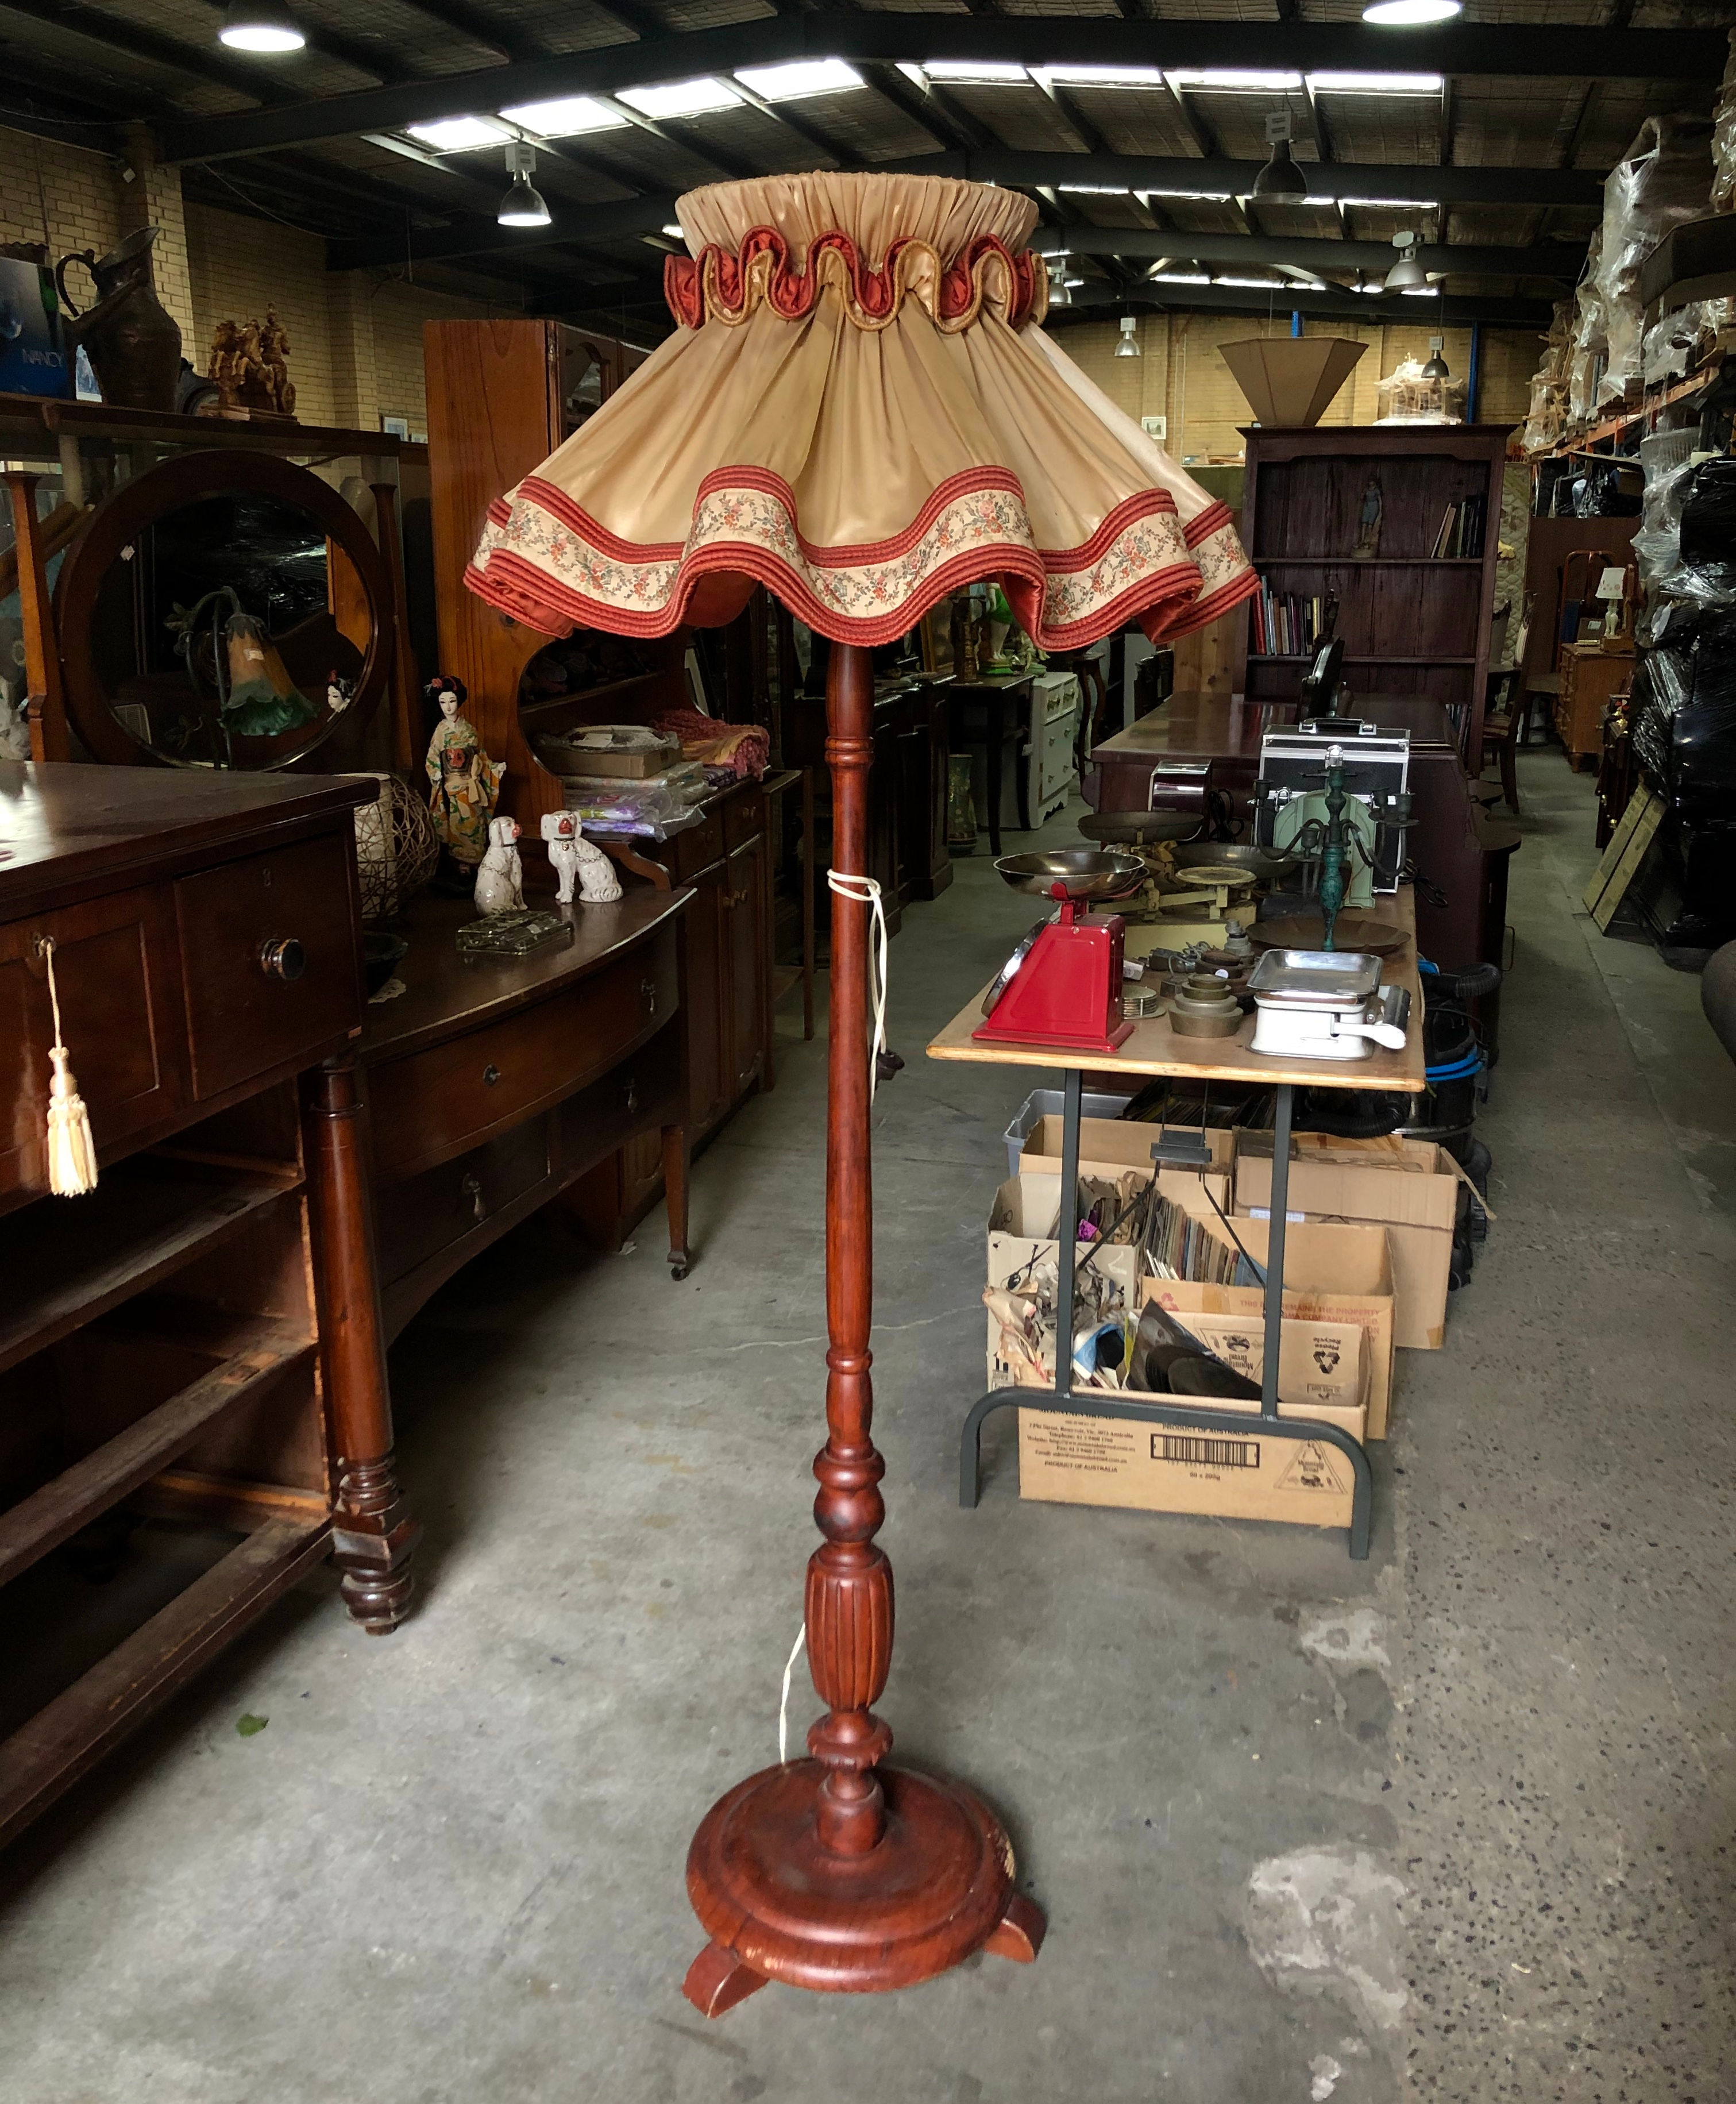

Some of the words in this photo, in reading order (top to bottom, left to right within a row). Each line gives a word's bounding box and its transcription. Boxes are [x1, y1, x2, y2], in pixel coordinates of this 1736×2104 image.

[1319, 1306, 1333, 1314] THE
[1336, 1308, 1379, 1316] PROPERTY
[1044, 1460, 1073, 1469] PRODUCT
[1084, 1464, 1118, 1473] AUSTRALIA
